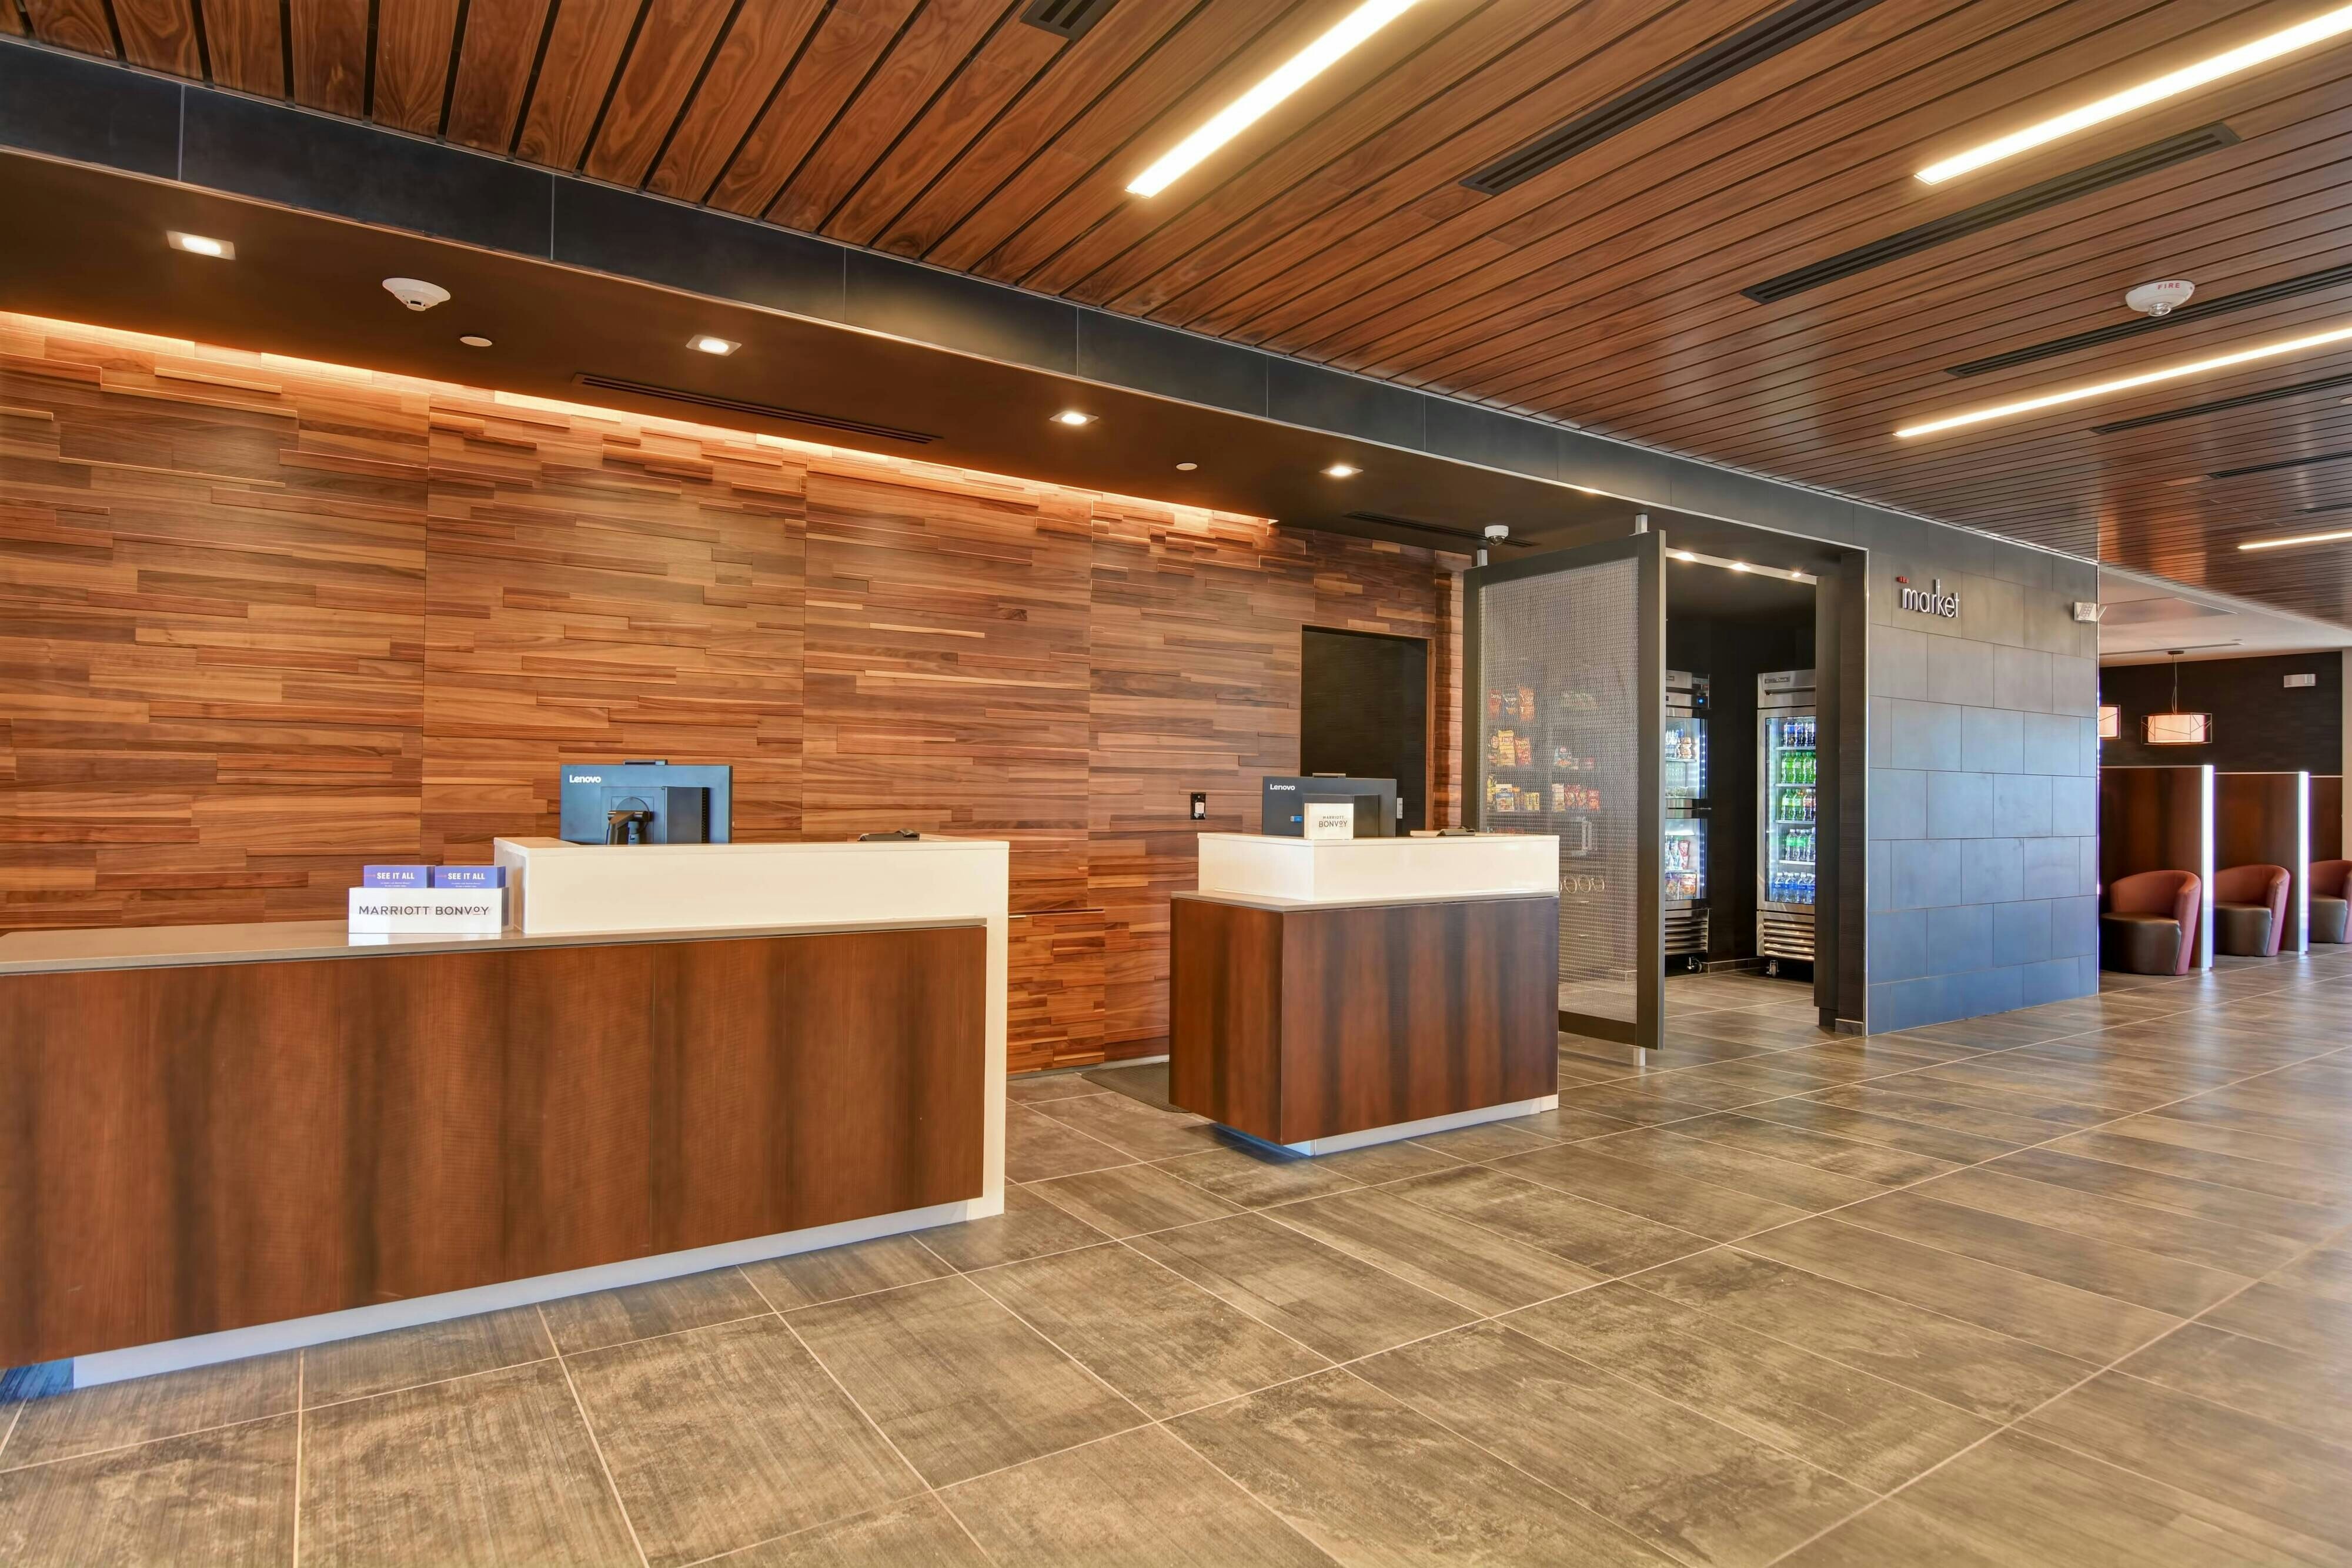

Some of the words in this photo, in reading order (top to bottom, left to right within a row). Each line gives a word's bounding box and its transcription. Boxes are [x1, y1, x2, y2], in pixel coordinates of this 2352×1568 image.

[1903, 579, 1960, 618] market
[569, 774, 602, 783] Lenovo
[359, 906, 430, 915] MARRIOTT
